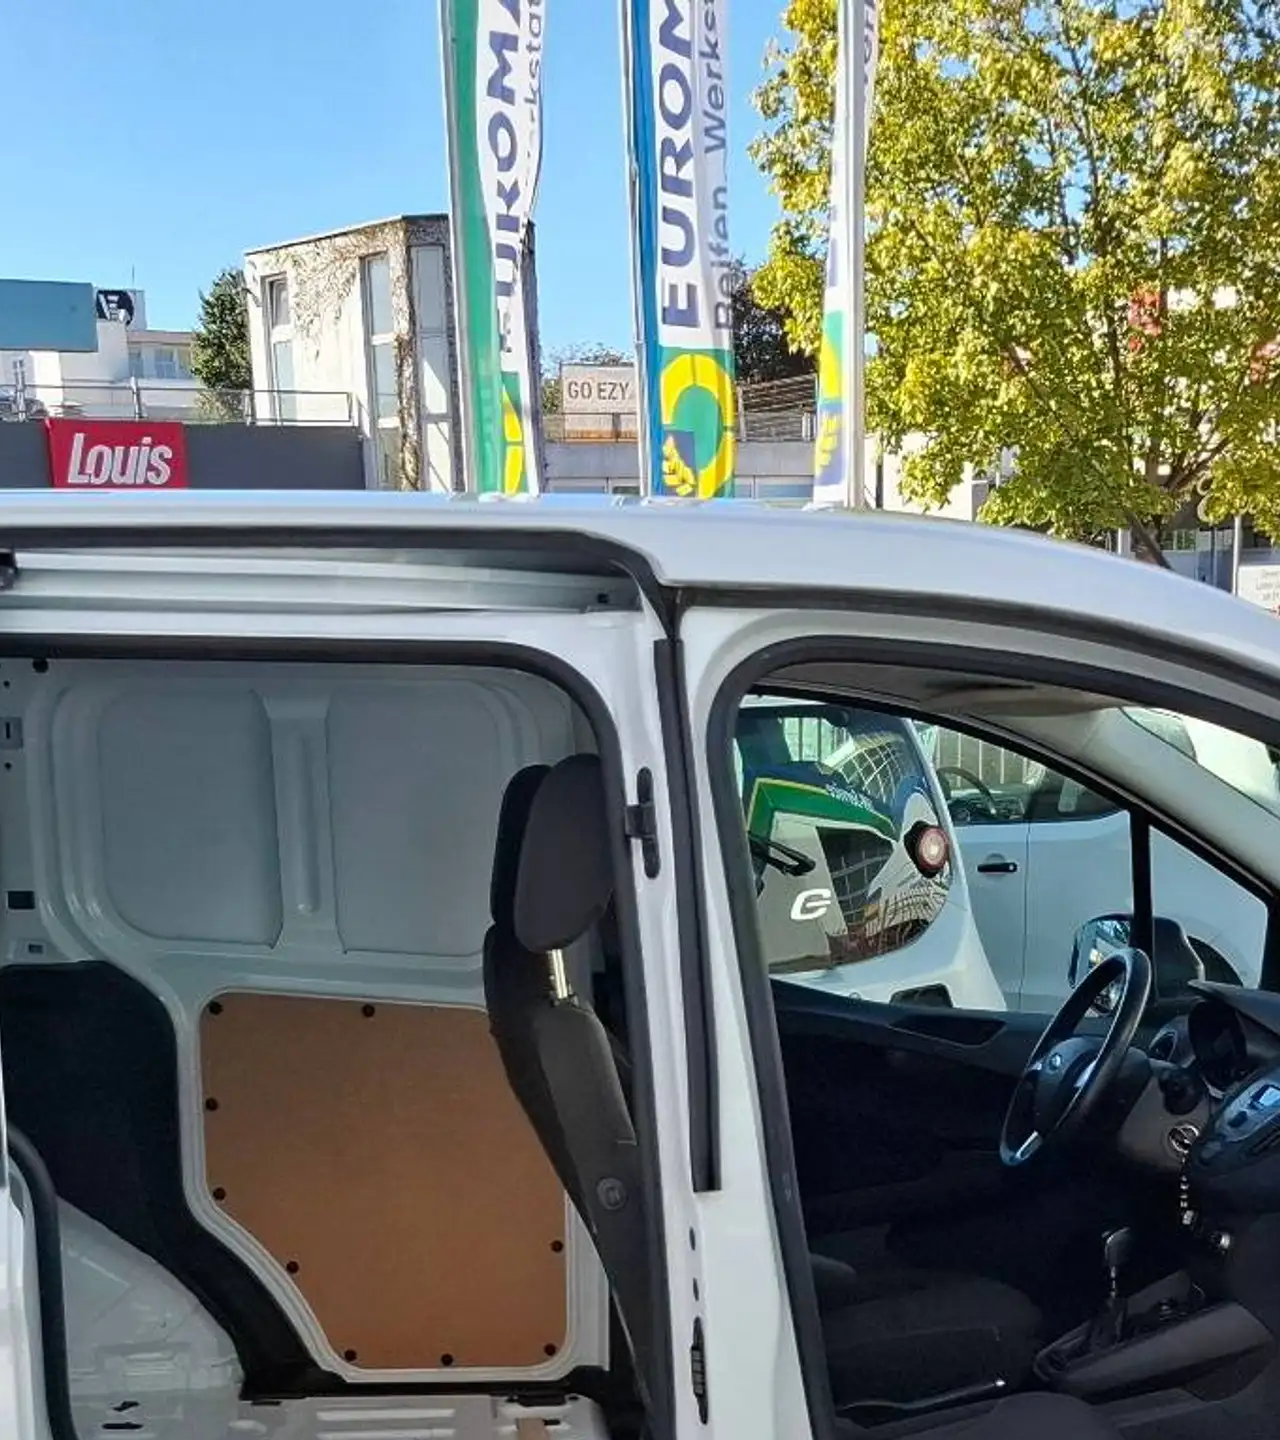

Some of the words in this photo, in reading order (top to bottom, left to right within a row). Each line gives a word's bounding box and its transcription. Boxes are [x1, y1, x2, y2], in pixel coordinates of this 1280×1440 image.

[568, 381, 593, 400] GO
[597, 381, 629, 401] EZY
[68, 432, 172, 485] Louis
